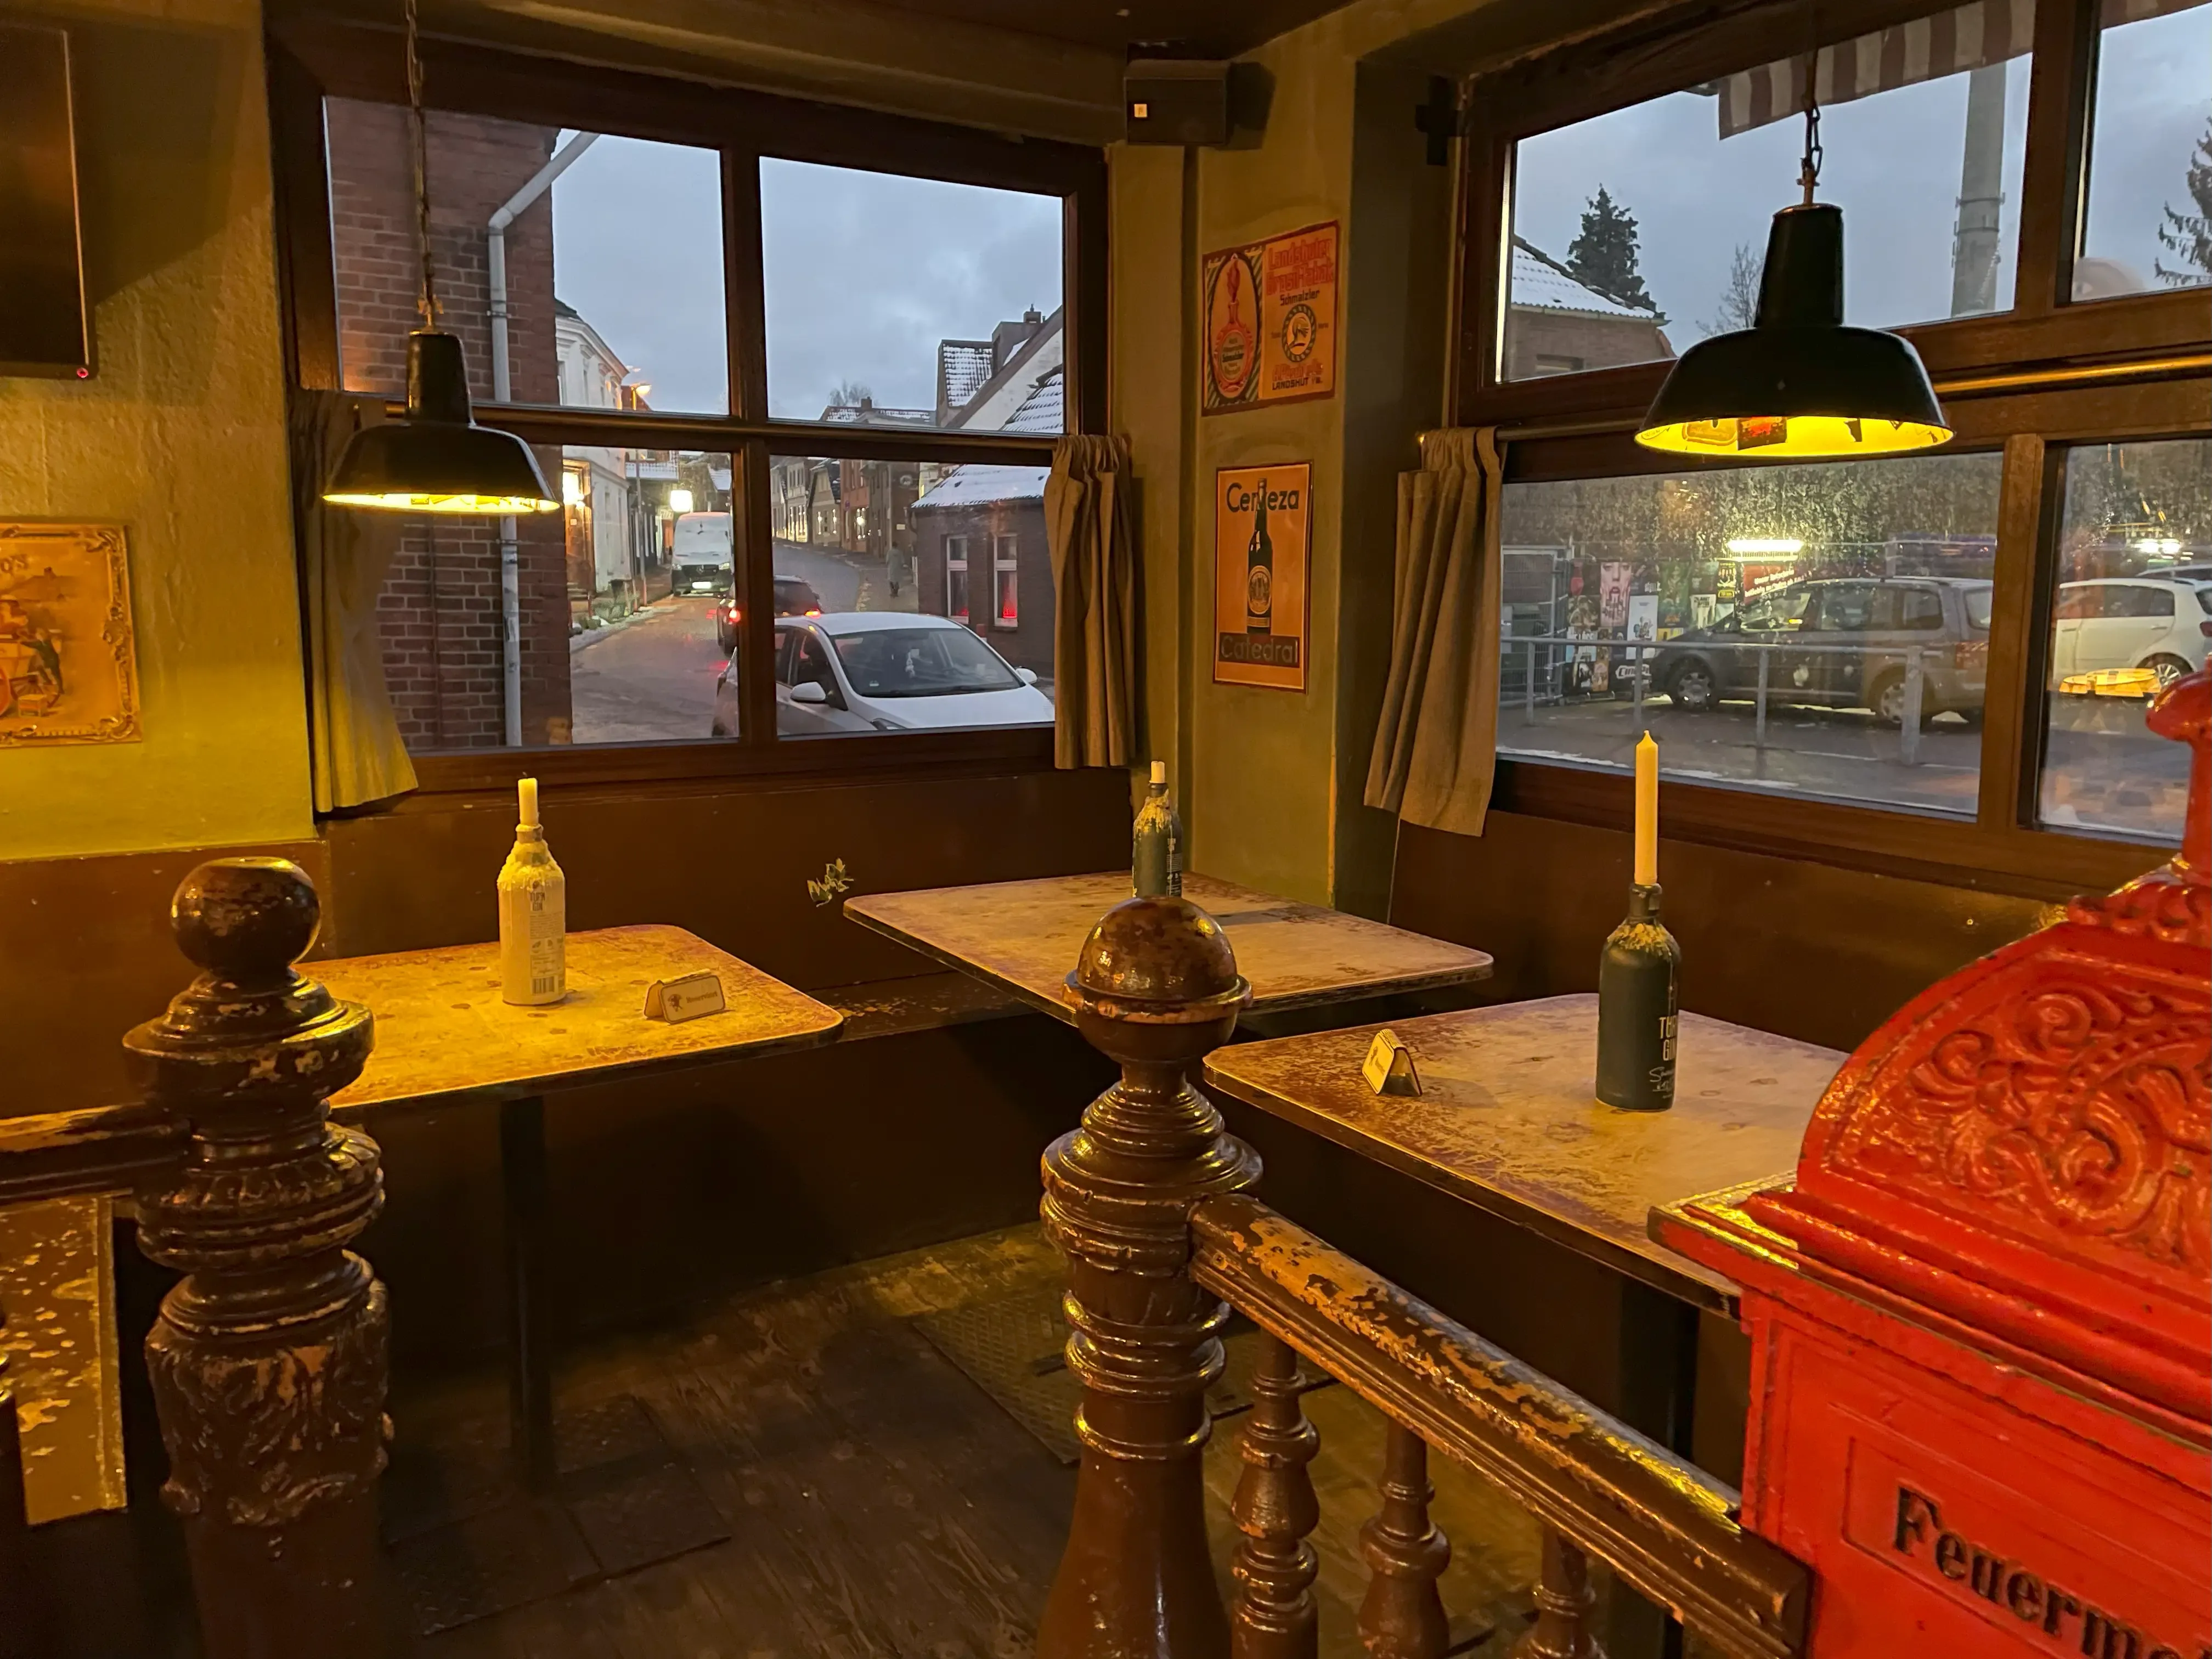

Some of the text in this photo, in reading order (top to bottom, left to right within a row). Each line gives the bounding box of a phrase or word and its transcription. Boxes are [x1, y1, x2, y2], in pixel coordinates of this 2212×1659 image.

[1272, 377, 1309, 391] LANDSHUT
[1227, 482, 1300, 512] Cereza
[1221, 635, 1298, 664] Catedral
[1893, 1482, 2212, 1659] Feuerm
